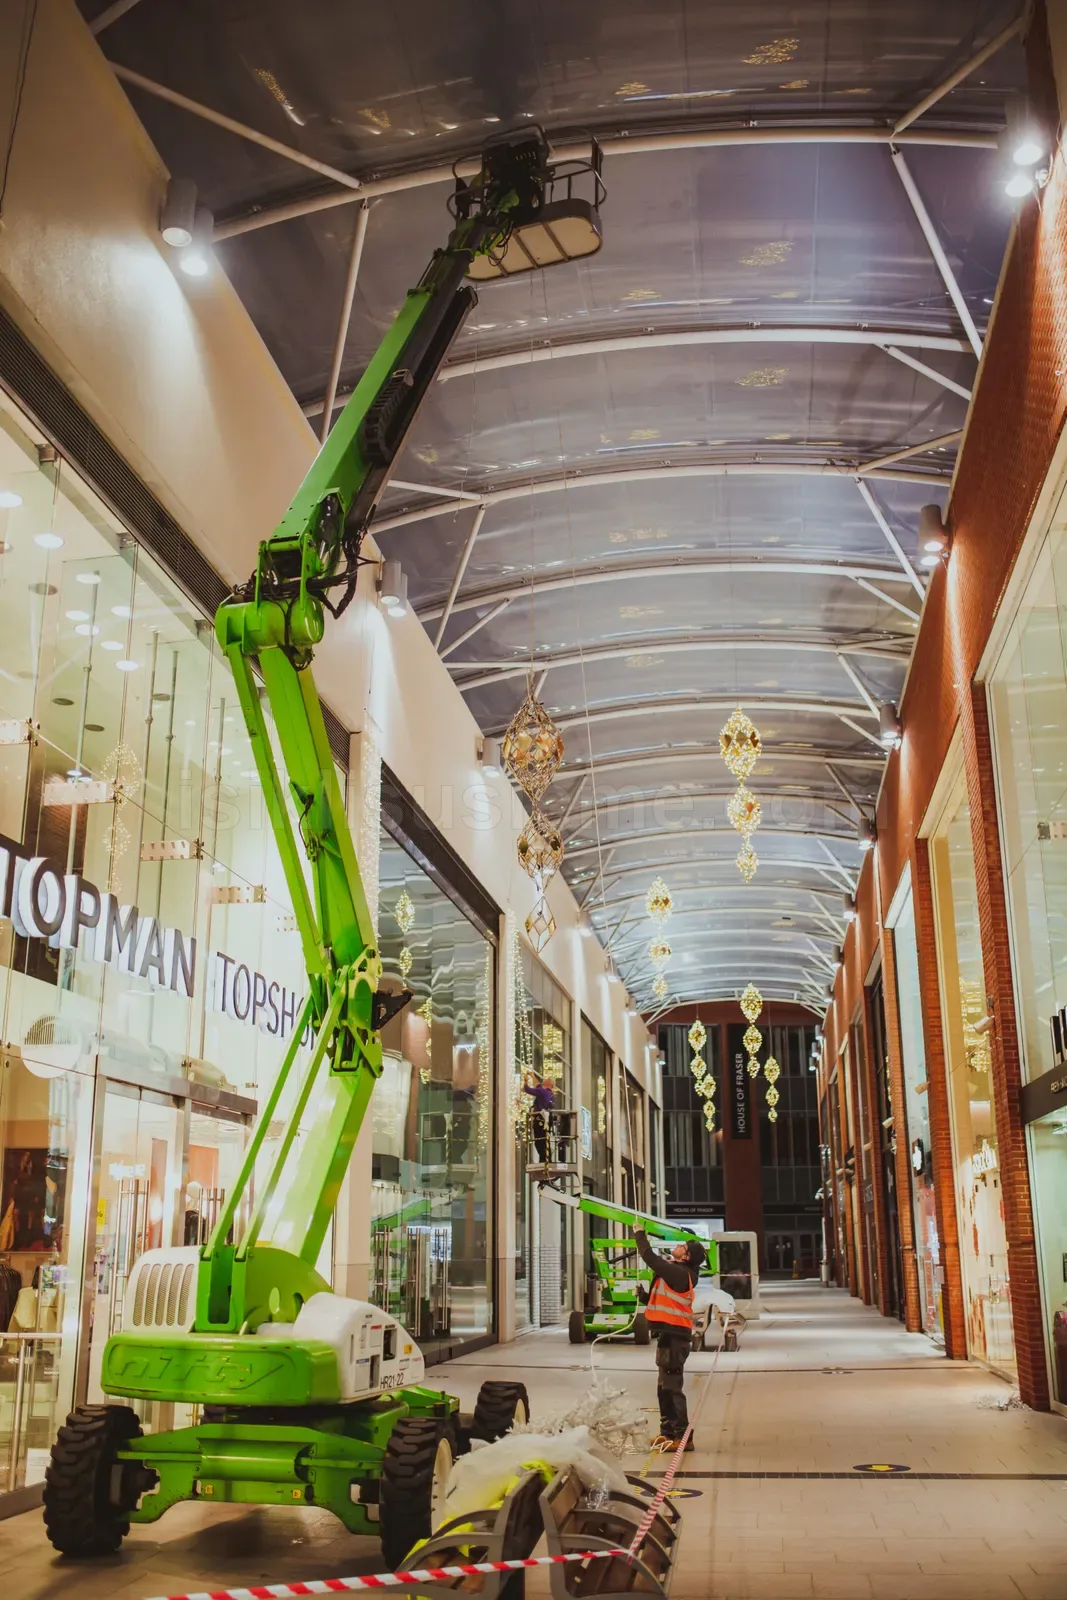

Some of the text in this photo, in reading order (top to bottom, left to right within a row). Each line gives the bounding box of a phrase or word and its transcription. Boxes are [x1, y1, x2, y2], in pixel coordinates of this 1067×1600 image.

[0, 834, 197, 998] TOPMAN
[735, 1052, 746, 1133] HOUSE OF FRASER
